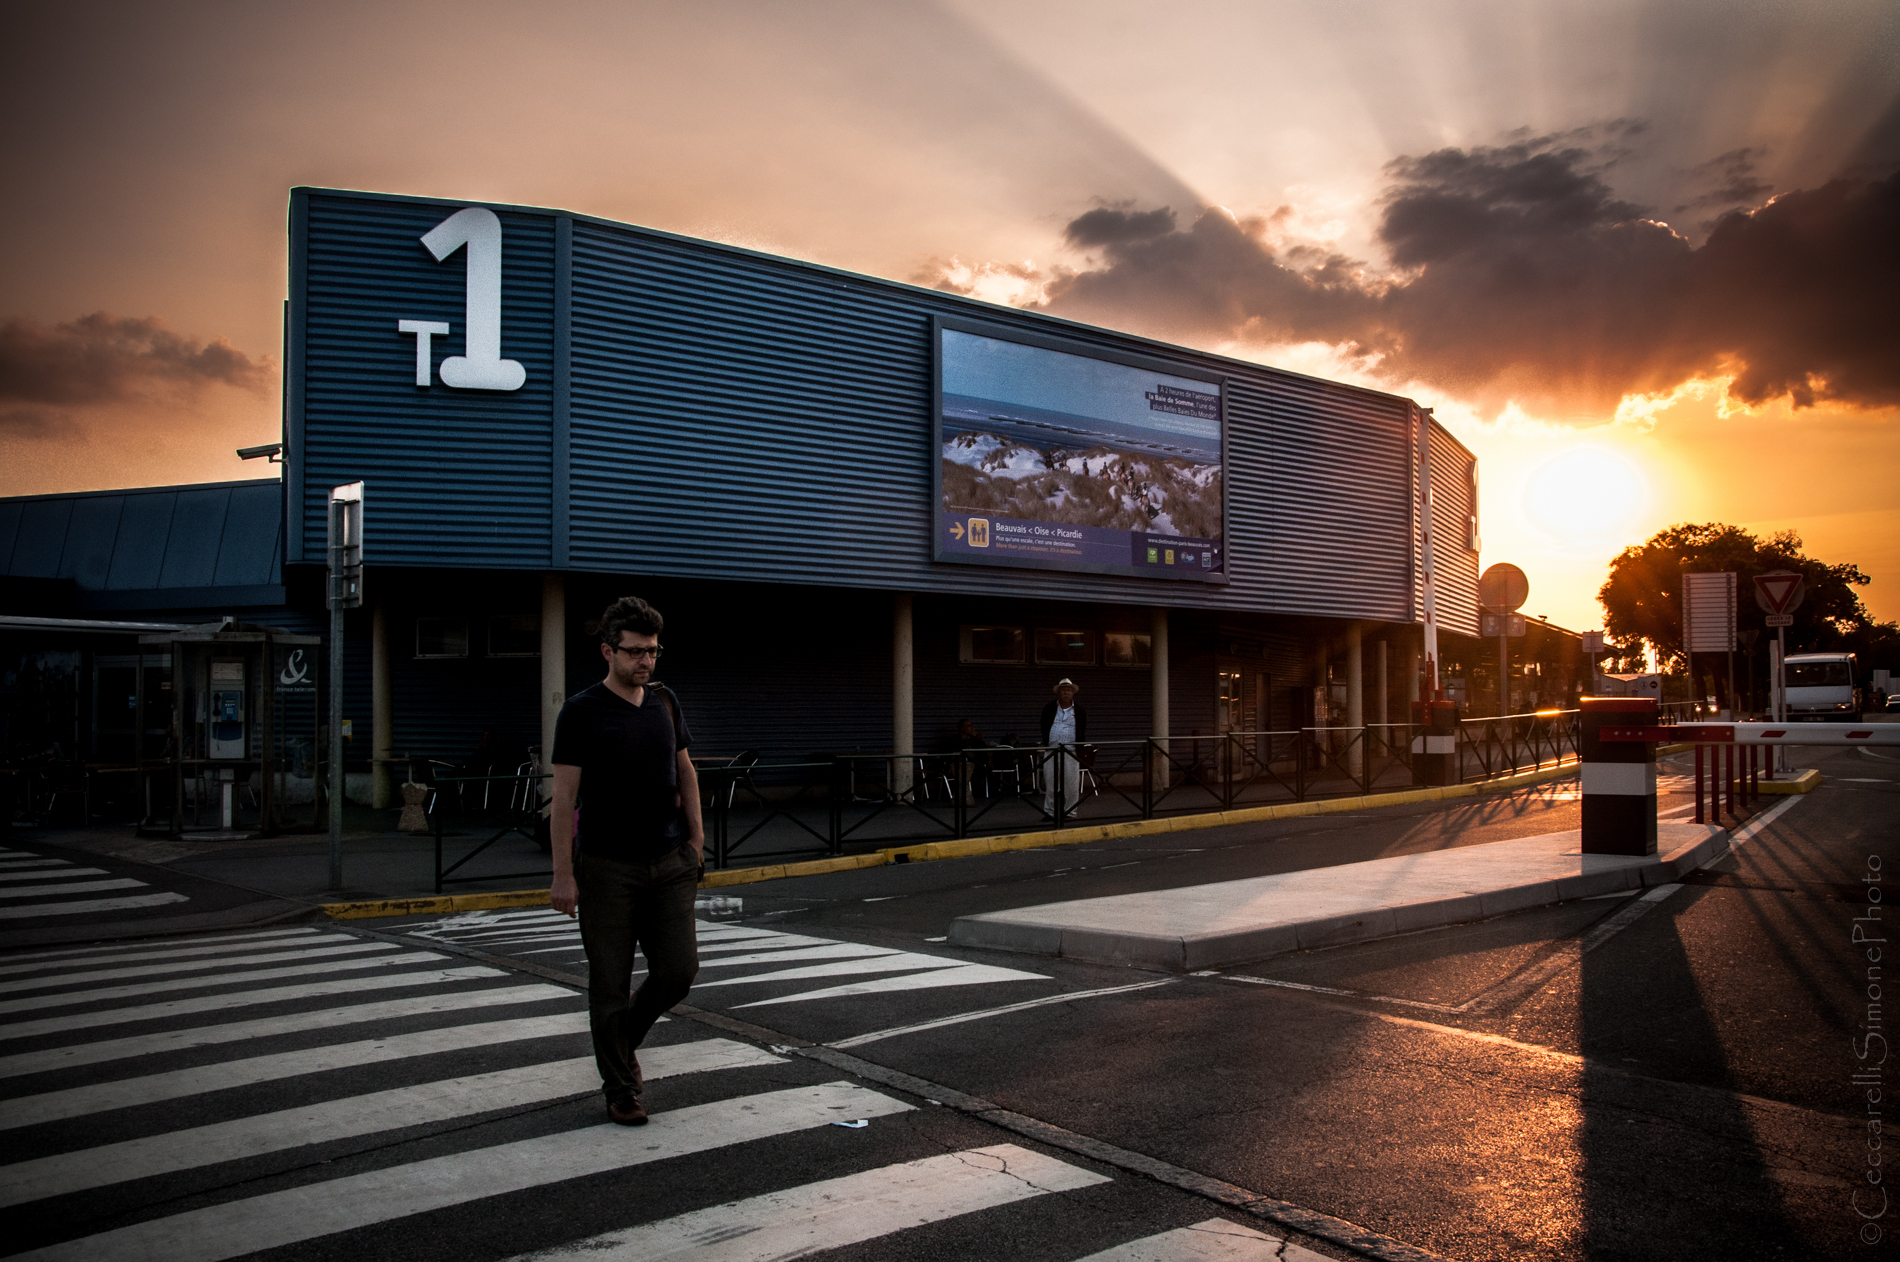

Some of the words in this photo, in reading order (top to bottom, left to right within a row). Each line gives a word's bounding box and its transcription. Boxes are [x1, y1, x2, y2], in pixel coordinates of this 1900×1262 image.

[1169, 389, 1185, 397] heures
[1152, 402, 1163, 411] plus
[1163, 404, 1177, 413] Belles
[1178, 407, 1190, 416] Baies
[1155, 394, 1167, 403] Baie
[1175, 398, 1195, 408] Somme,
[1208, 403, 1217, 411] des
[995, 523, 1027, 534] Beauvais
[1034, 526, 1050, 536] Oise
[1057, 528, 1083, 539] Picardie
